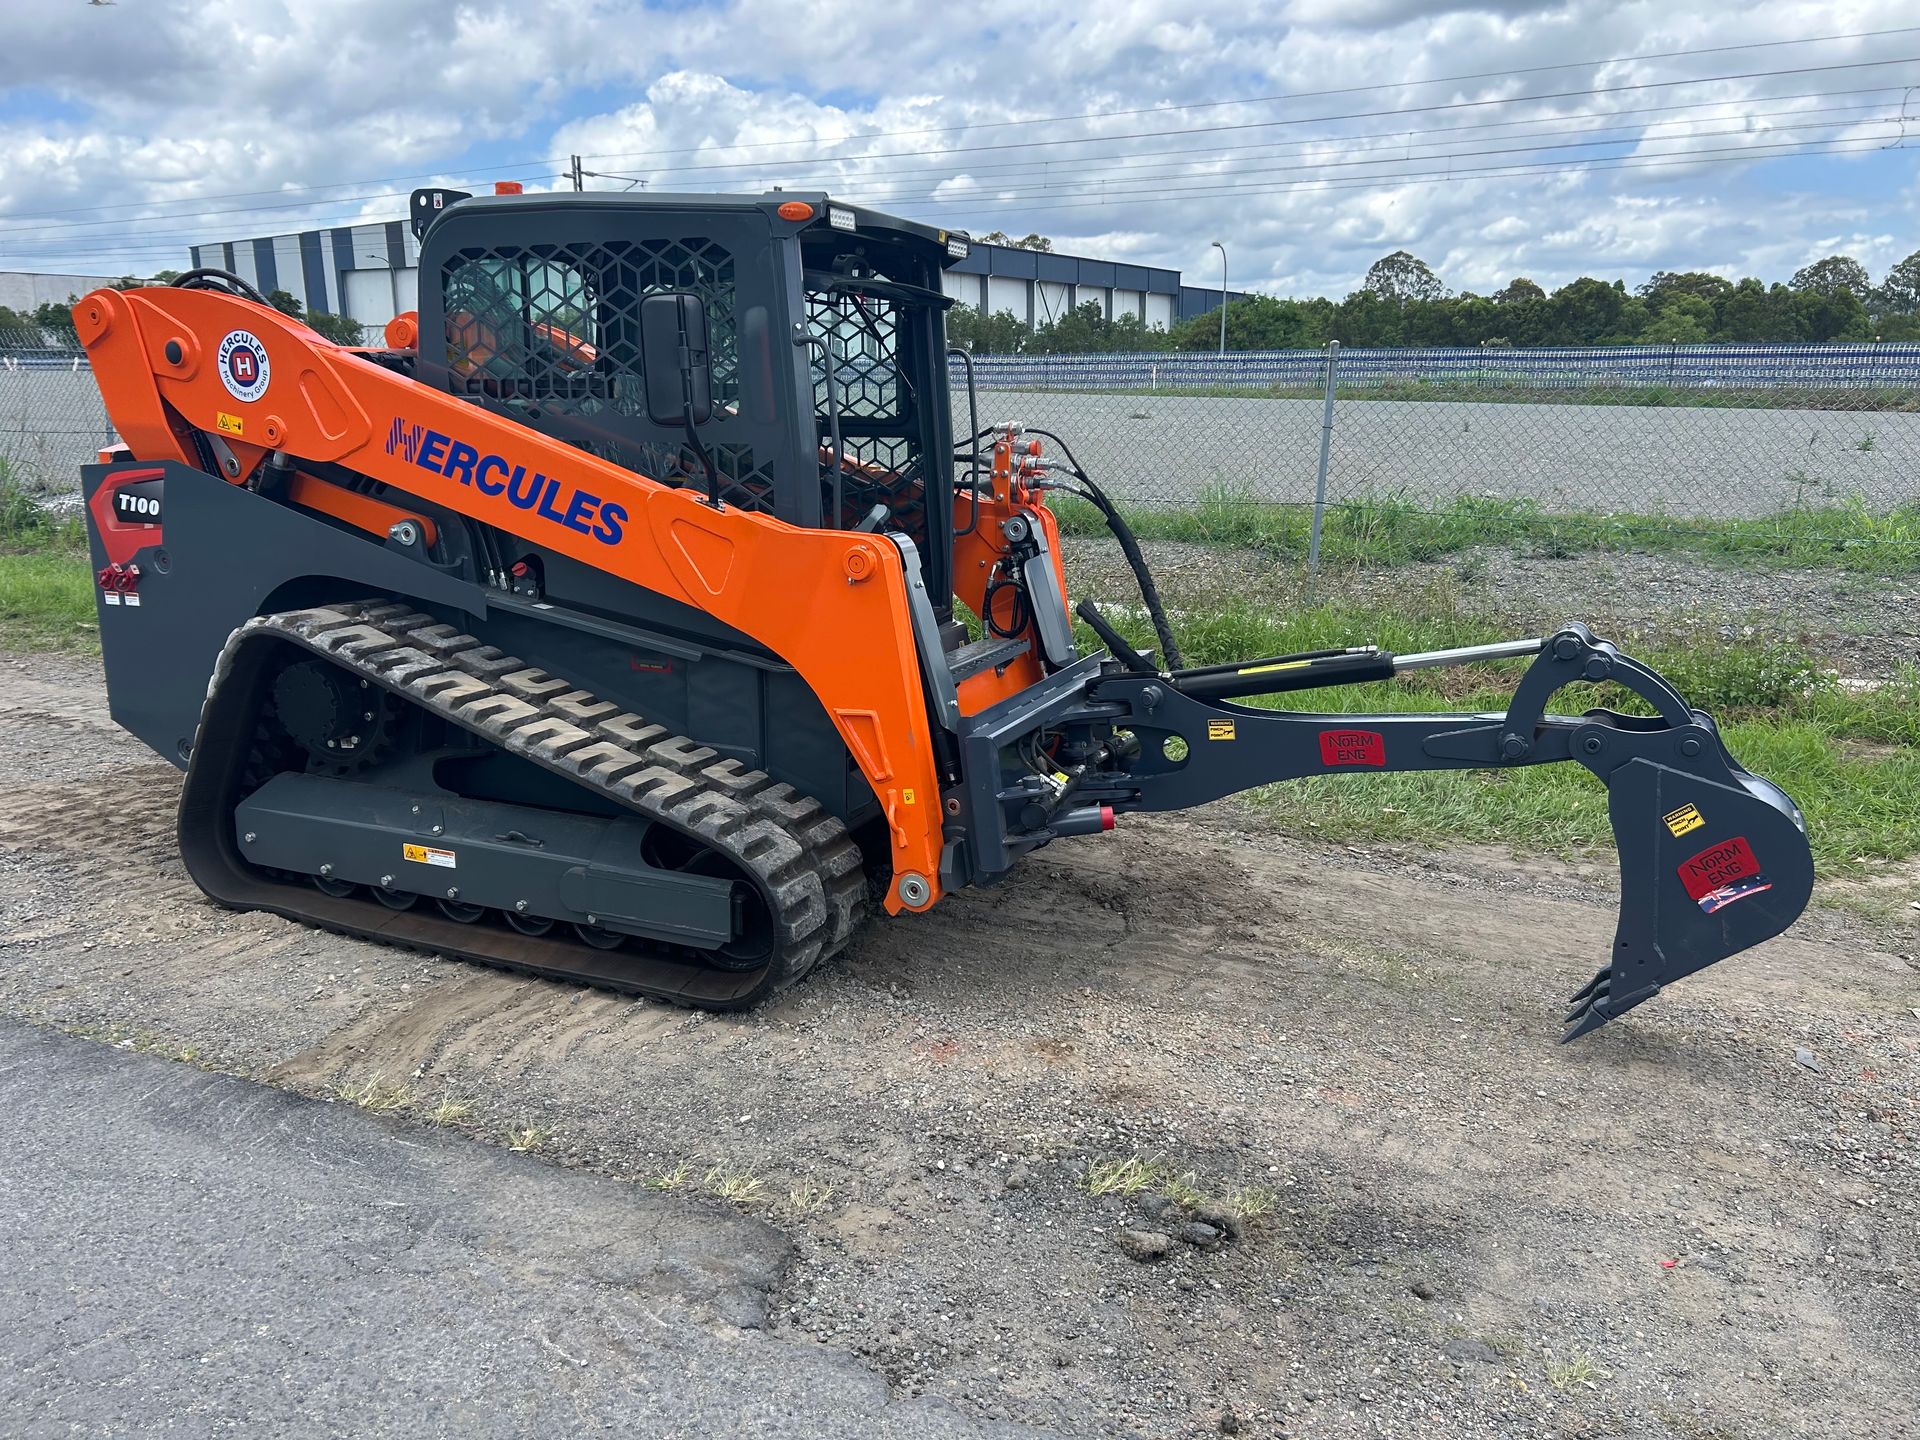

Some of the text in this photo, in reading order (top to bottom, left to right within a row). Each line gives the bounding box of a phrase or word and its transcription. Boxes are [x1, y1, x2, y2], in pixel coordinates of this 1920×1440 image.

[220, 332, 267, 364] HERCULES
[236, 357, 252, 376] H
[223, 369, 268, 398] Machinery Group
[384, 416, 629, 546] HERCULES
[119, 494, 160, 516] T100
[1337, 749, 1366, 761] ENG
[1666, 807, 1692, 822] WARNING
[1670, 818, 1687, 828] PINCH
[1674, 824, 1690, 834] POINT
[1707, 861, 1742, 886] ENG
